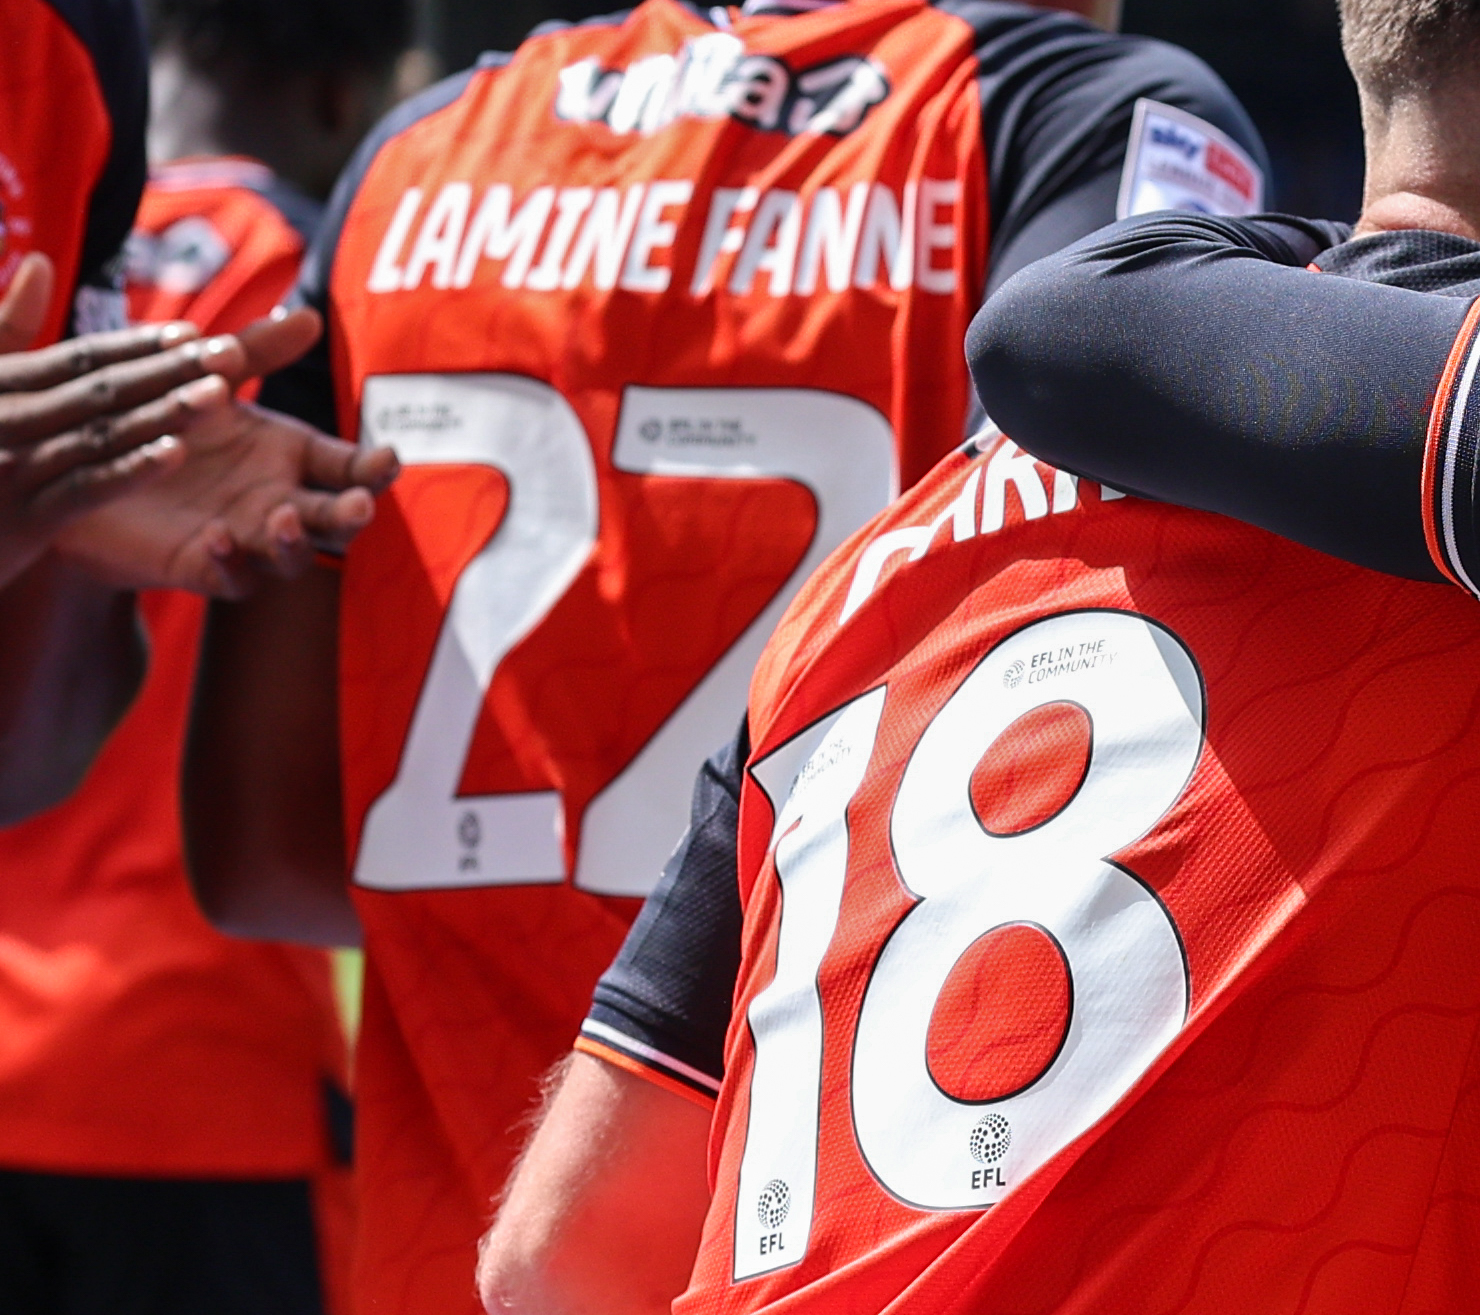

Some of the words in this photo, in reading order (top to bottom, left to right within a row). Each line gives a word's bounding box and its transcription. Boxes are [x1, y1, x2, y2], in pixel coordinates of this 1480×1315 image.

[366, 178, 692, 296] LAMINE
[691, 178, 959, 296] FANNE
[353, 371, 903, 898] 22
[1027, 651, 1119, 685] COMMUNITY
[1031, 650, 1054, 669] EFL
[1057, 645, 1075, 662] IN
[1078, 639, 1106, 656] THE
[733, 607, 1207, 1284] 18
[971, 1167, 1006, 1190] EFL
[759, 1232, 785, 1255] EFL
